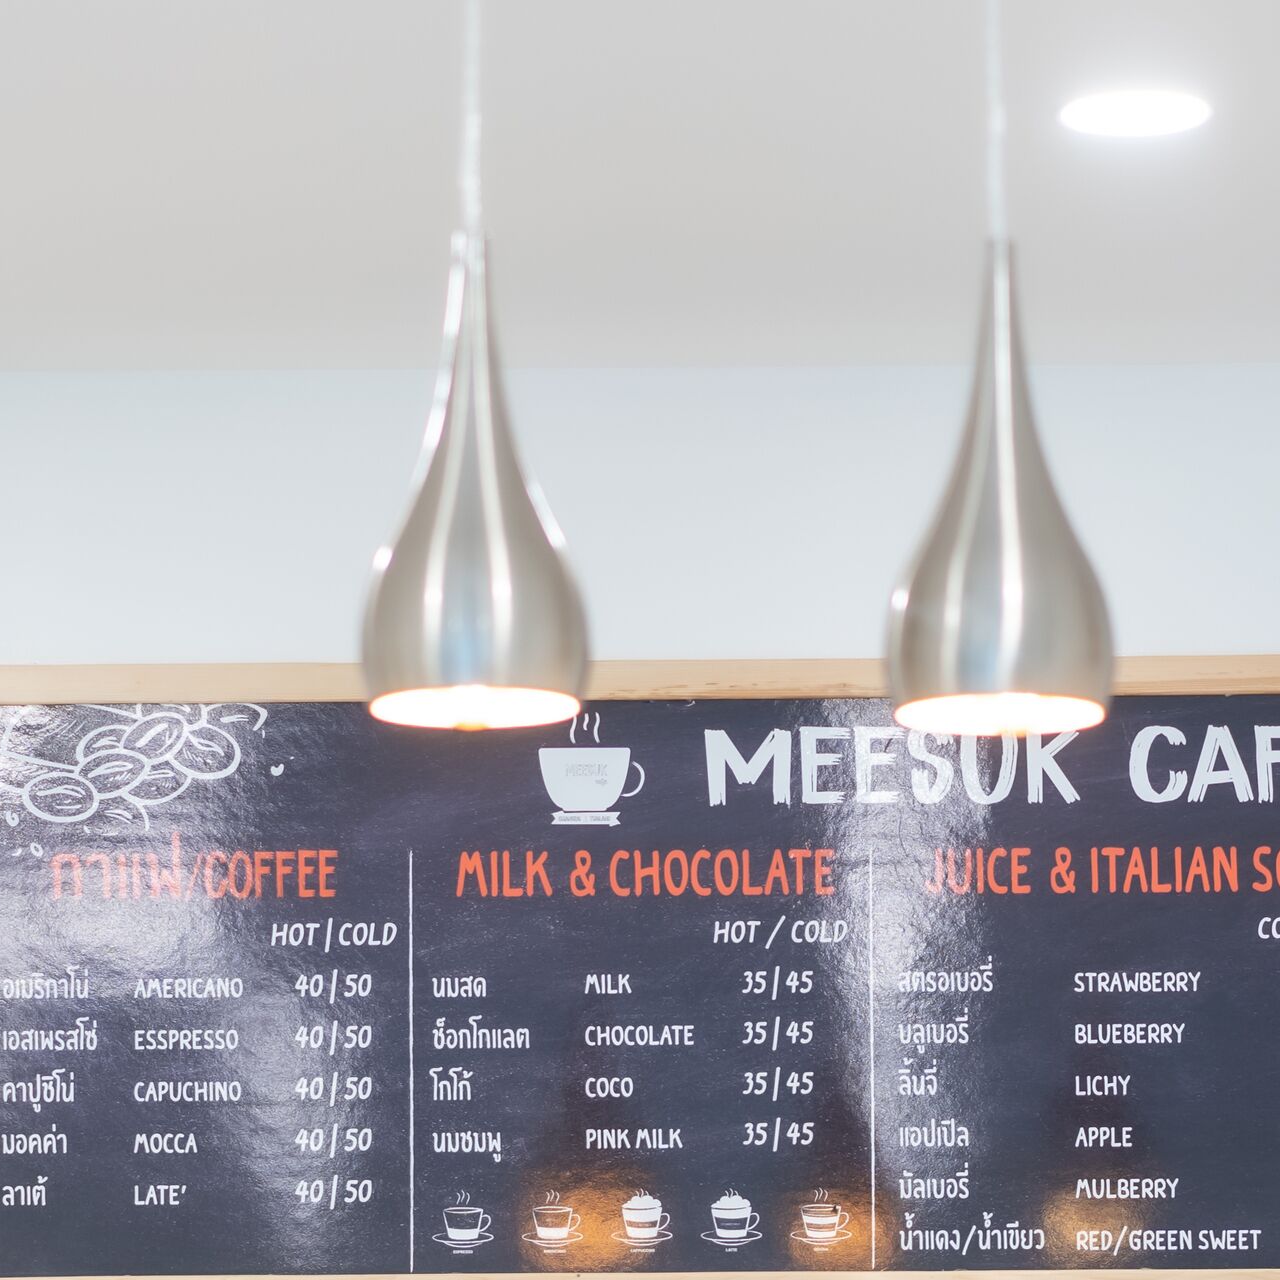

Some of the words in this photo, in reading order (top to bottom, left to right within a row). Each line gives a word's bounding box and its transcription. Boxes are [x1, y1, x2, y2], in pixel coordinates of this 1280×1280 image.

[704, 725, 1081, 806] MEESUK
[456, 850, 553, 897] MILK
[569, 850, 596, 897] &
[609, 849, 835, 895] CHOCOLATE
[927, 847, 1032, 894] JUICE
[1050, 846, 1076, 894] &
[1090, 846, 1239, 894] ITALIAN
[131, 975, 244, 999] AMERICANO
[431, 975, 487, 998] นมสด
[584, 973, 632, 995] MILK
[1073, 971, 1201, 993] STRAWBERRY
[2, 1016, 98, 1051] เอสเพรสโซ่
[134, 1028, 241, 1053] ESSPRESSO
[432, 1014, 530, 1050] ช็อกโกแลต
[584, 1024, 695, 1047] CHOCOLATE
[1074, 1022, 1186, 1045] BLUEBERRY
[2, 1068, 75, 1113] คาปูชิโน่
[133, 1080, 242, 1102] CAPUCHINO
[428, 1066, 474, 1101] โกโก้
[585, 1077, 634, 1098] COCO
[1075, 1074, 1131, 1096] LICHY
[1, 1123, 68, 1155] มอคค่า
[133, 1132, 198, 1154] MOCCA
[585, 1128, 631, 1150] PINK
[635, 1128, 683, 1149] MILK
[899, 1119, 970, 1147] แอปเปิล
[1074, 1126, 1133, 1148] APPLE
[431, 1130, 502, 1163] นมชมพู
[2, 1175, 49, 1207] ลาเต้
[1075, 1177, 1179, 1200] MULBERRY
[1075, 1226, 1194, 1255] RED/GREEN
[1197, 1230, 1261, 1251] SWEET
